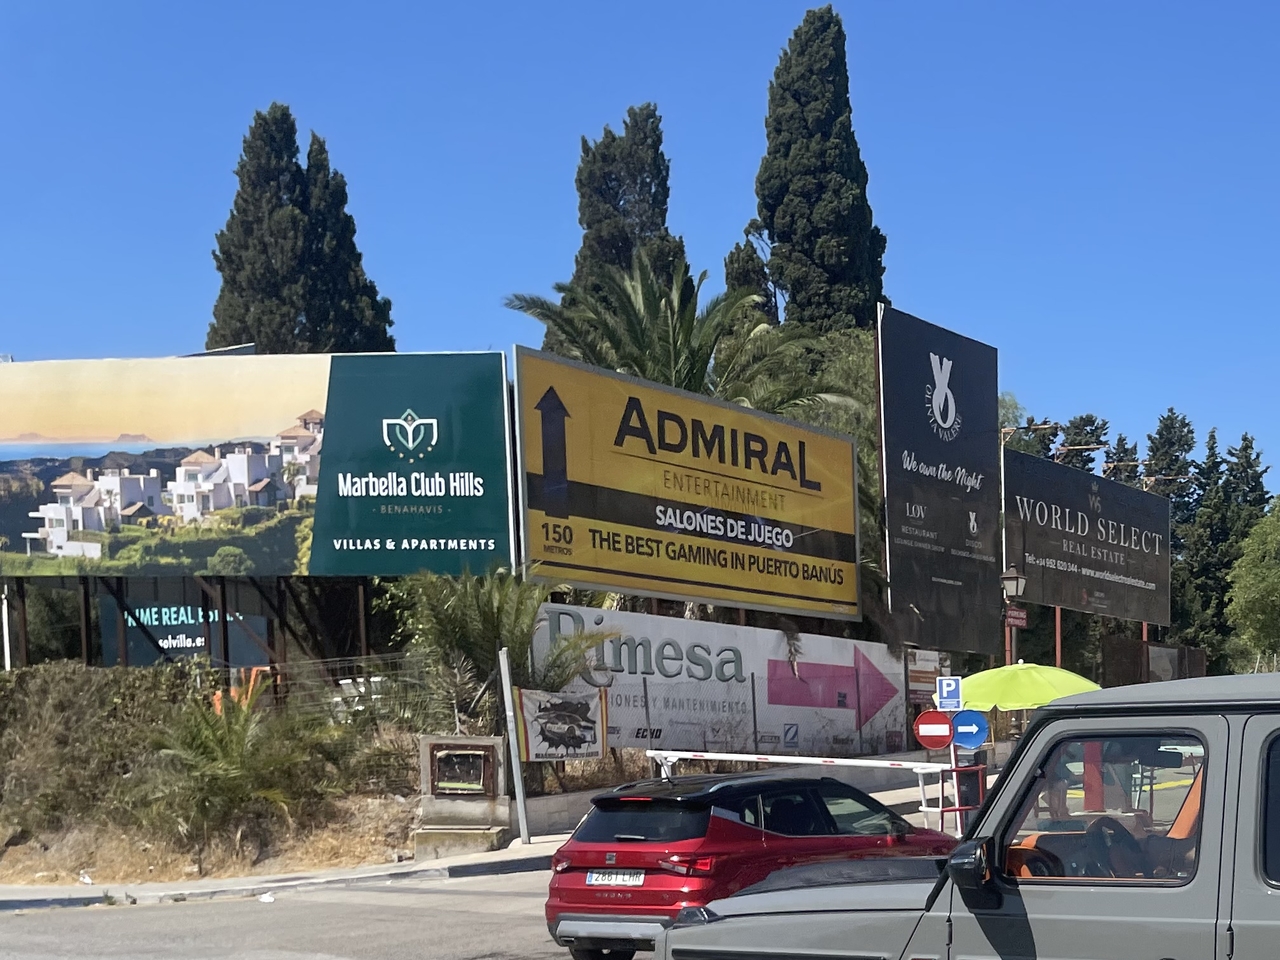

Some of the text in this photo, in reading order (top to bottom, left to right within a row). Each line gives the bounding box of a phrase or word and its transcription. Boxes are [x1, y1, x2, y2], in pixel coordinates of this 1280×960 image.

[614, 396, 822, 492] ADMIRAL
[337, 471, 484, 497] Marbella Club Hills
[902, 450, 918, 472] We
[937, 463, 953, 481] the
[955, 466, 984, 493] Night
[663, 469, 786, 512] ENTERTAINMENT
[380, 505, 443, 514] BENAHAVIS
[541, 522, 573, 544] 150
[655, 505, 794, 548] SALONES DE JUEGO
[901, 525, 938, 540] RESTAURANT
[1015, 495, 1163, 556] WORLD SELECT
[333, 538, 496, 550] VILLAS & APARTMENTS
[543, 545, 572, 556] METROS
[589, 529, 844, 585] THE BEST GAMING IN PUERTO BANÚS
[1062, 538, 1126, 566] REAL ESTATE
[162, 606, 195, 625] REAL
[942, 680, 956, 697] P
